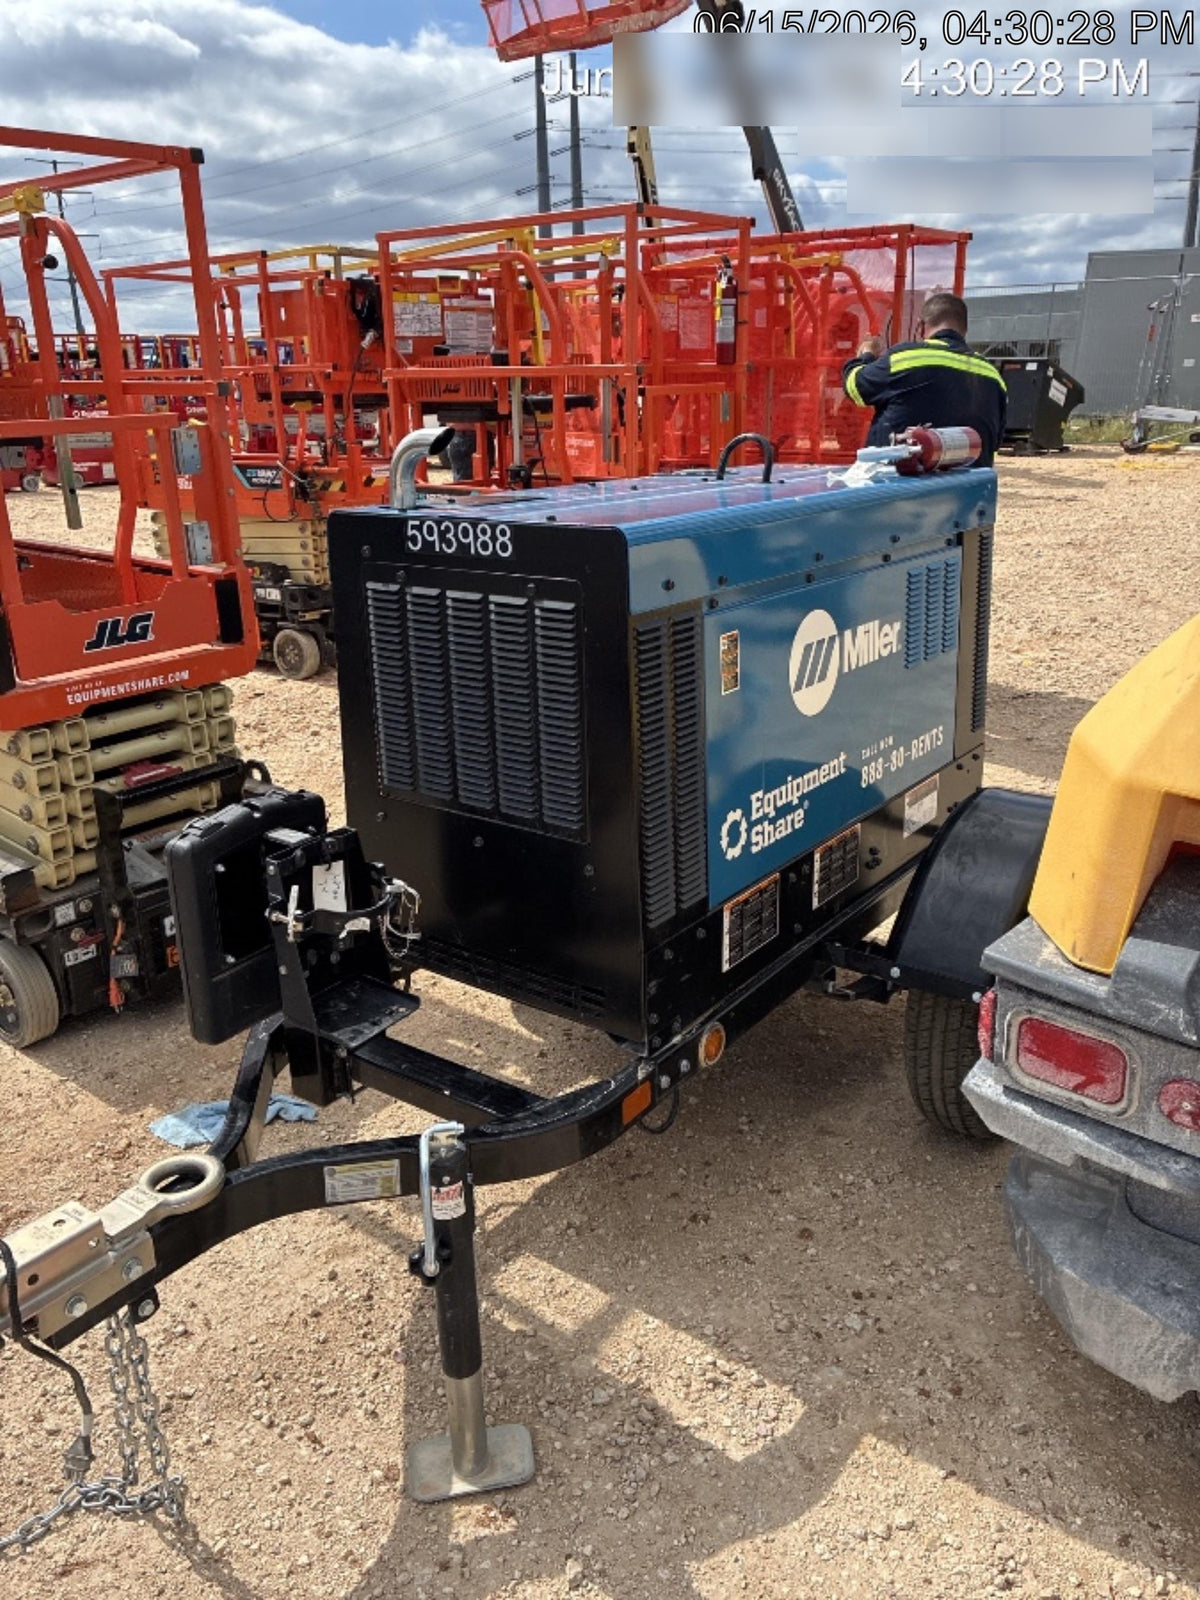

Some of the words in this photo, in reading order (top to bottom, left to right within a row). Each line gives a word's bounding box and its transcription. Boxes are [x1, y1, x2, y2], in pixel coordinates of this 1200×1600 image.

[406, 519, 513, 558] 593988
[83, 611, 155, 654] JLG
[843, 619, 901, 674] Miller
[66, 669, 191, 706] EQUIPMENTSHARE.COM
[861, 725, 944, 788] 888-80-RENTS
[750, 750, 847, 821] Equipment
